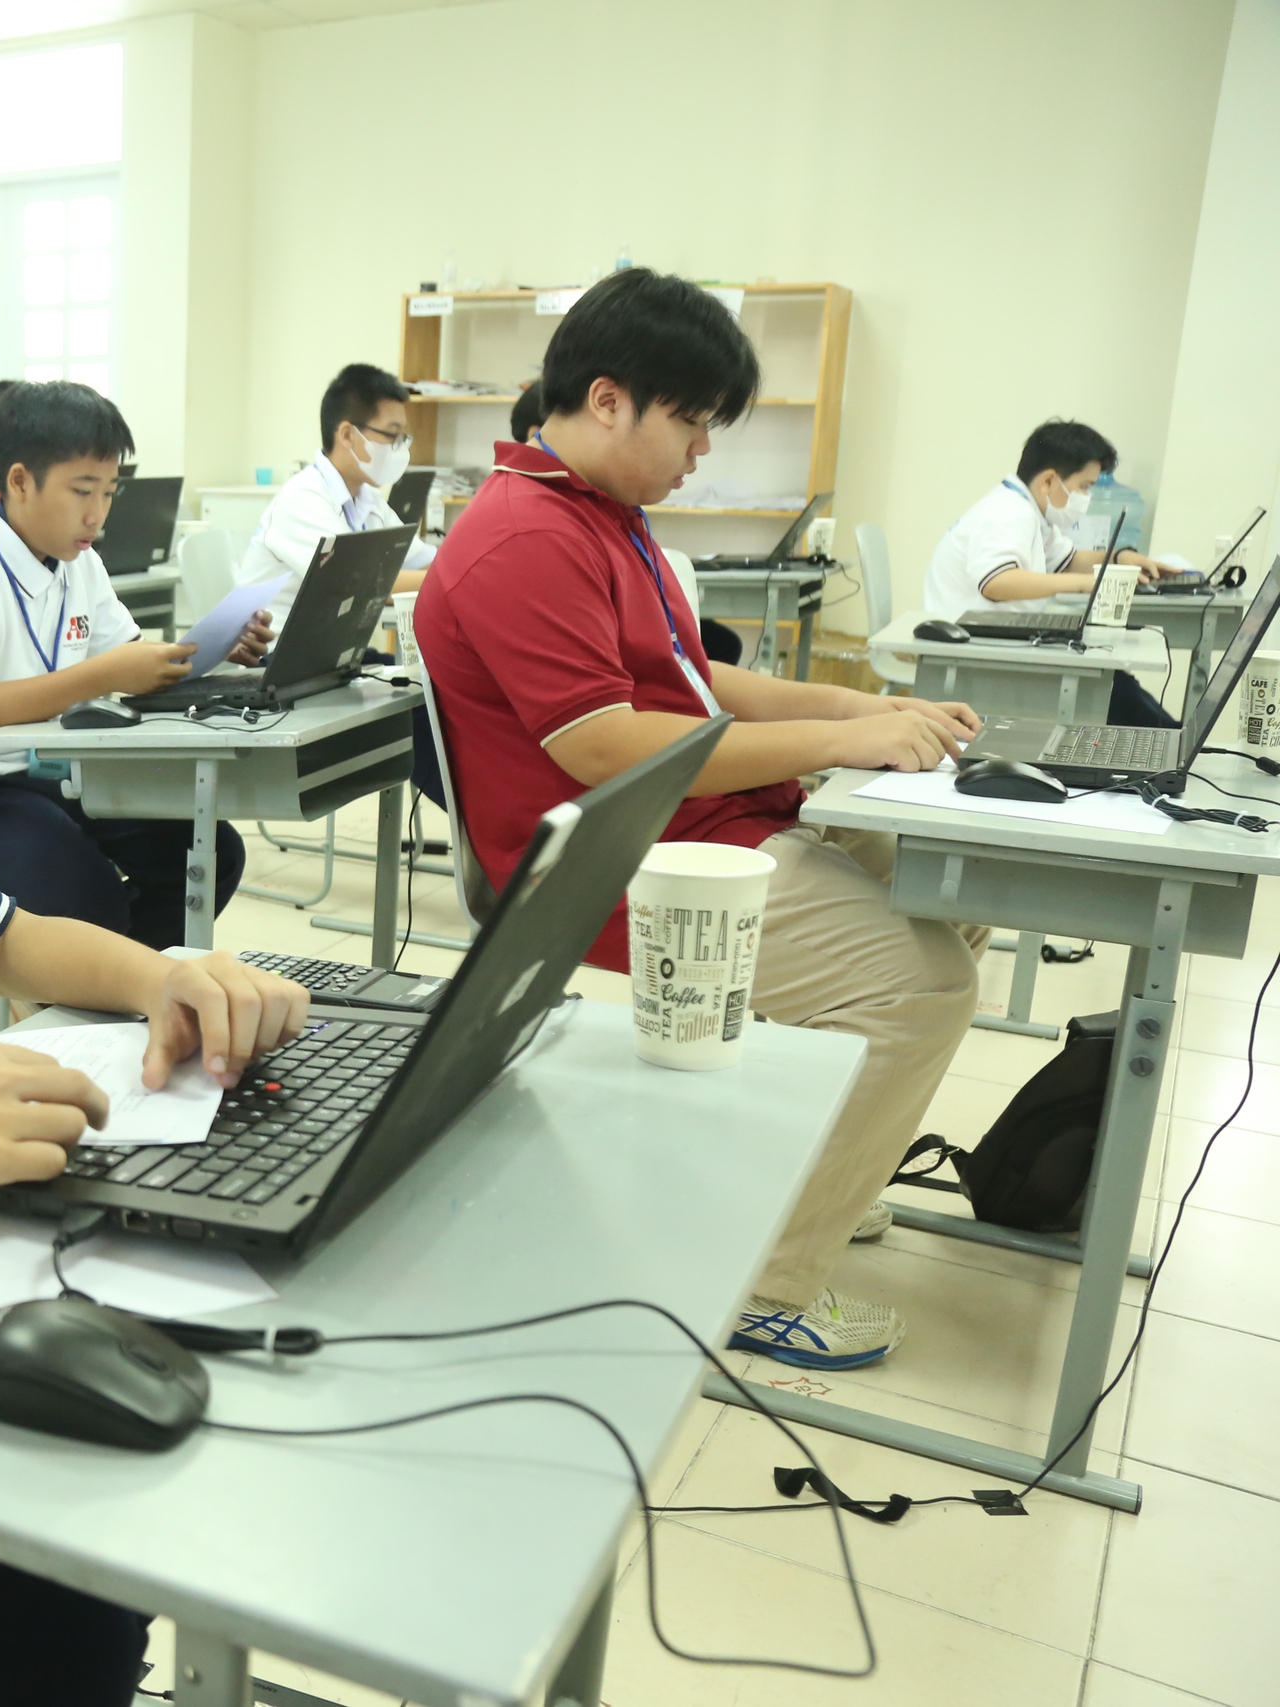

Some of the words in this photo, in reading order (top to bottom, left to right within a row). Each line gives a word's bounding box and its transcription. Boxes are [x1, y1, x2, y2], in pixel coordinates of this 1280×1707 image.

[1251, 679, 1268, 689] CAFE
[635, 920, 653, 939] TEA
[673, 907, 728, 962] TEA
[660, 983, 706, 1009] Coffee
[713, 984, 723, 1011] TEA
[662, 1006, 673, 1041] TEA
[676, 1010, 720, 1045] coffee
